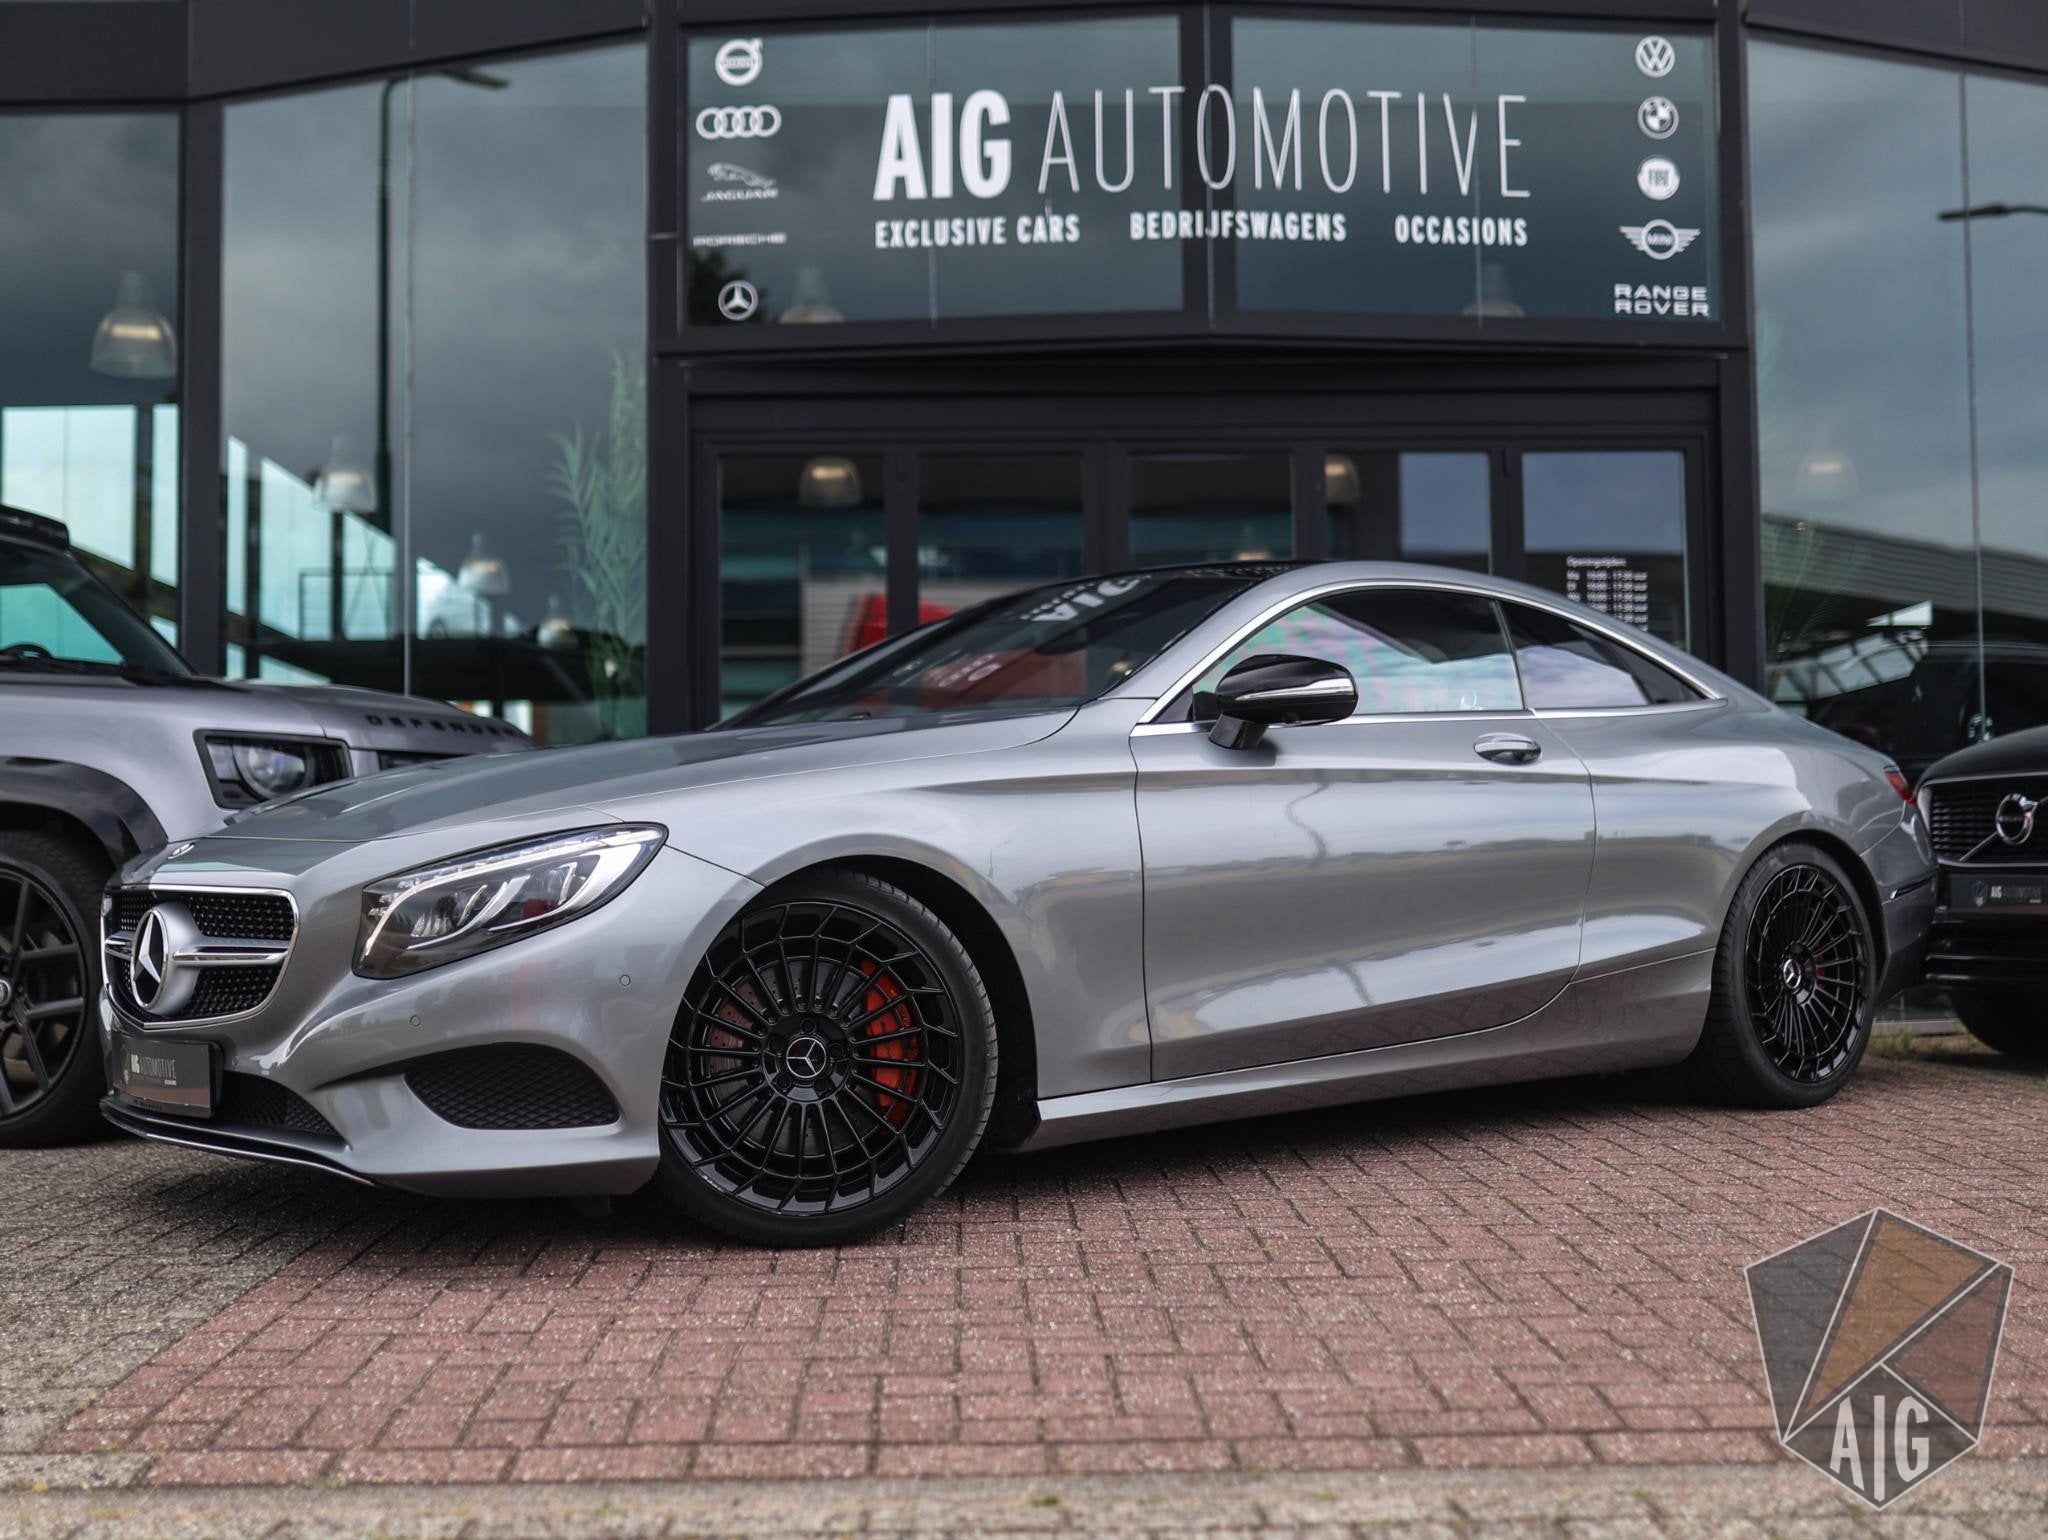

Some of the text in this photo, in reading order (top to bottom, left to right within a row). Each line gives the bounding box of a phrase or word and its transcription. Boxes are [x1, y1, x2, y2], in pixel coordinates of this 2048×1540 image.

[873, 85, 1531, 200] AIG AUTOMOTIVE
[875, 214, 1081, 249] EXCLUSIVE CARS
[1130, 209, 1346, 243] BEDRIJFSWAGENS
[1395, 214, 1528, 247] OCCASIONS
[1614, 283, 1707, 300] RANGE
[1614, 300, 1709, 316] ROVER
